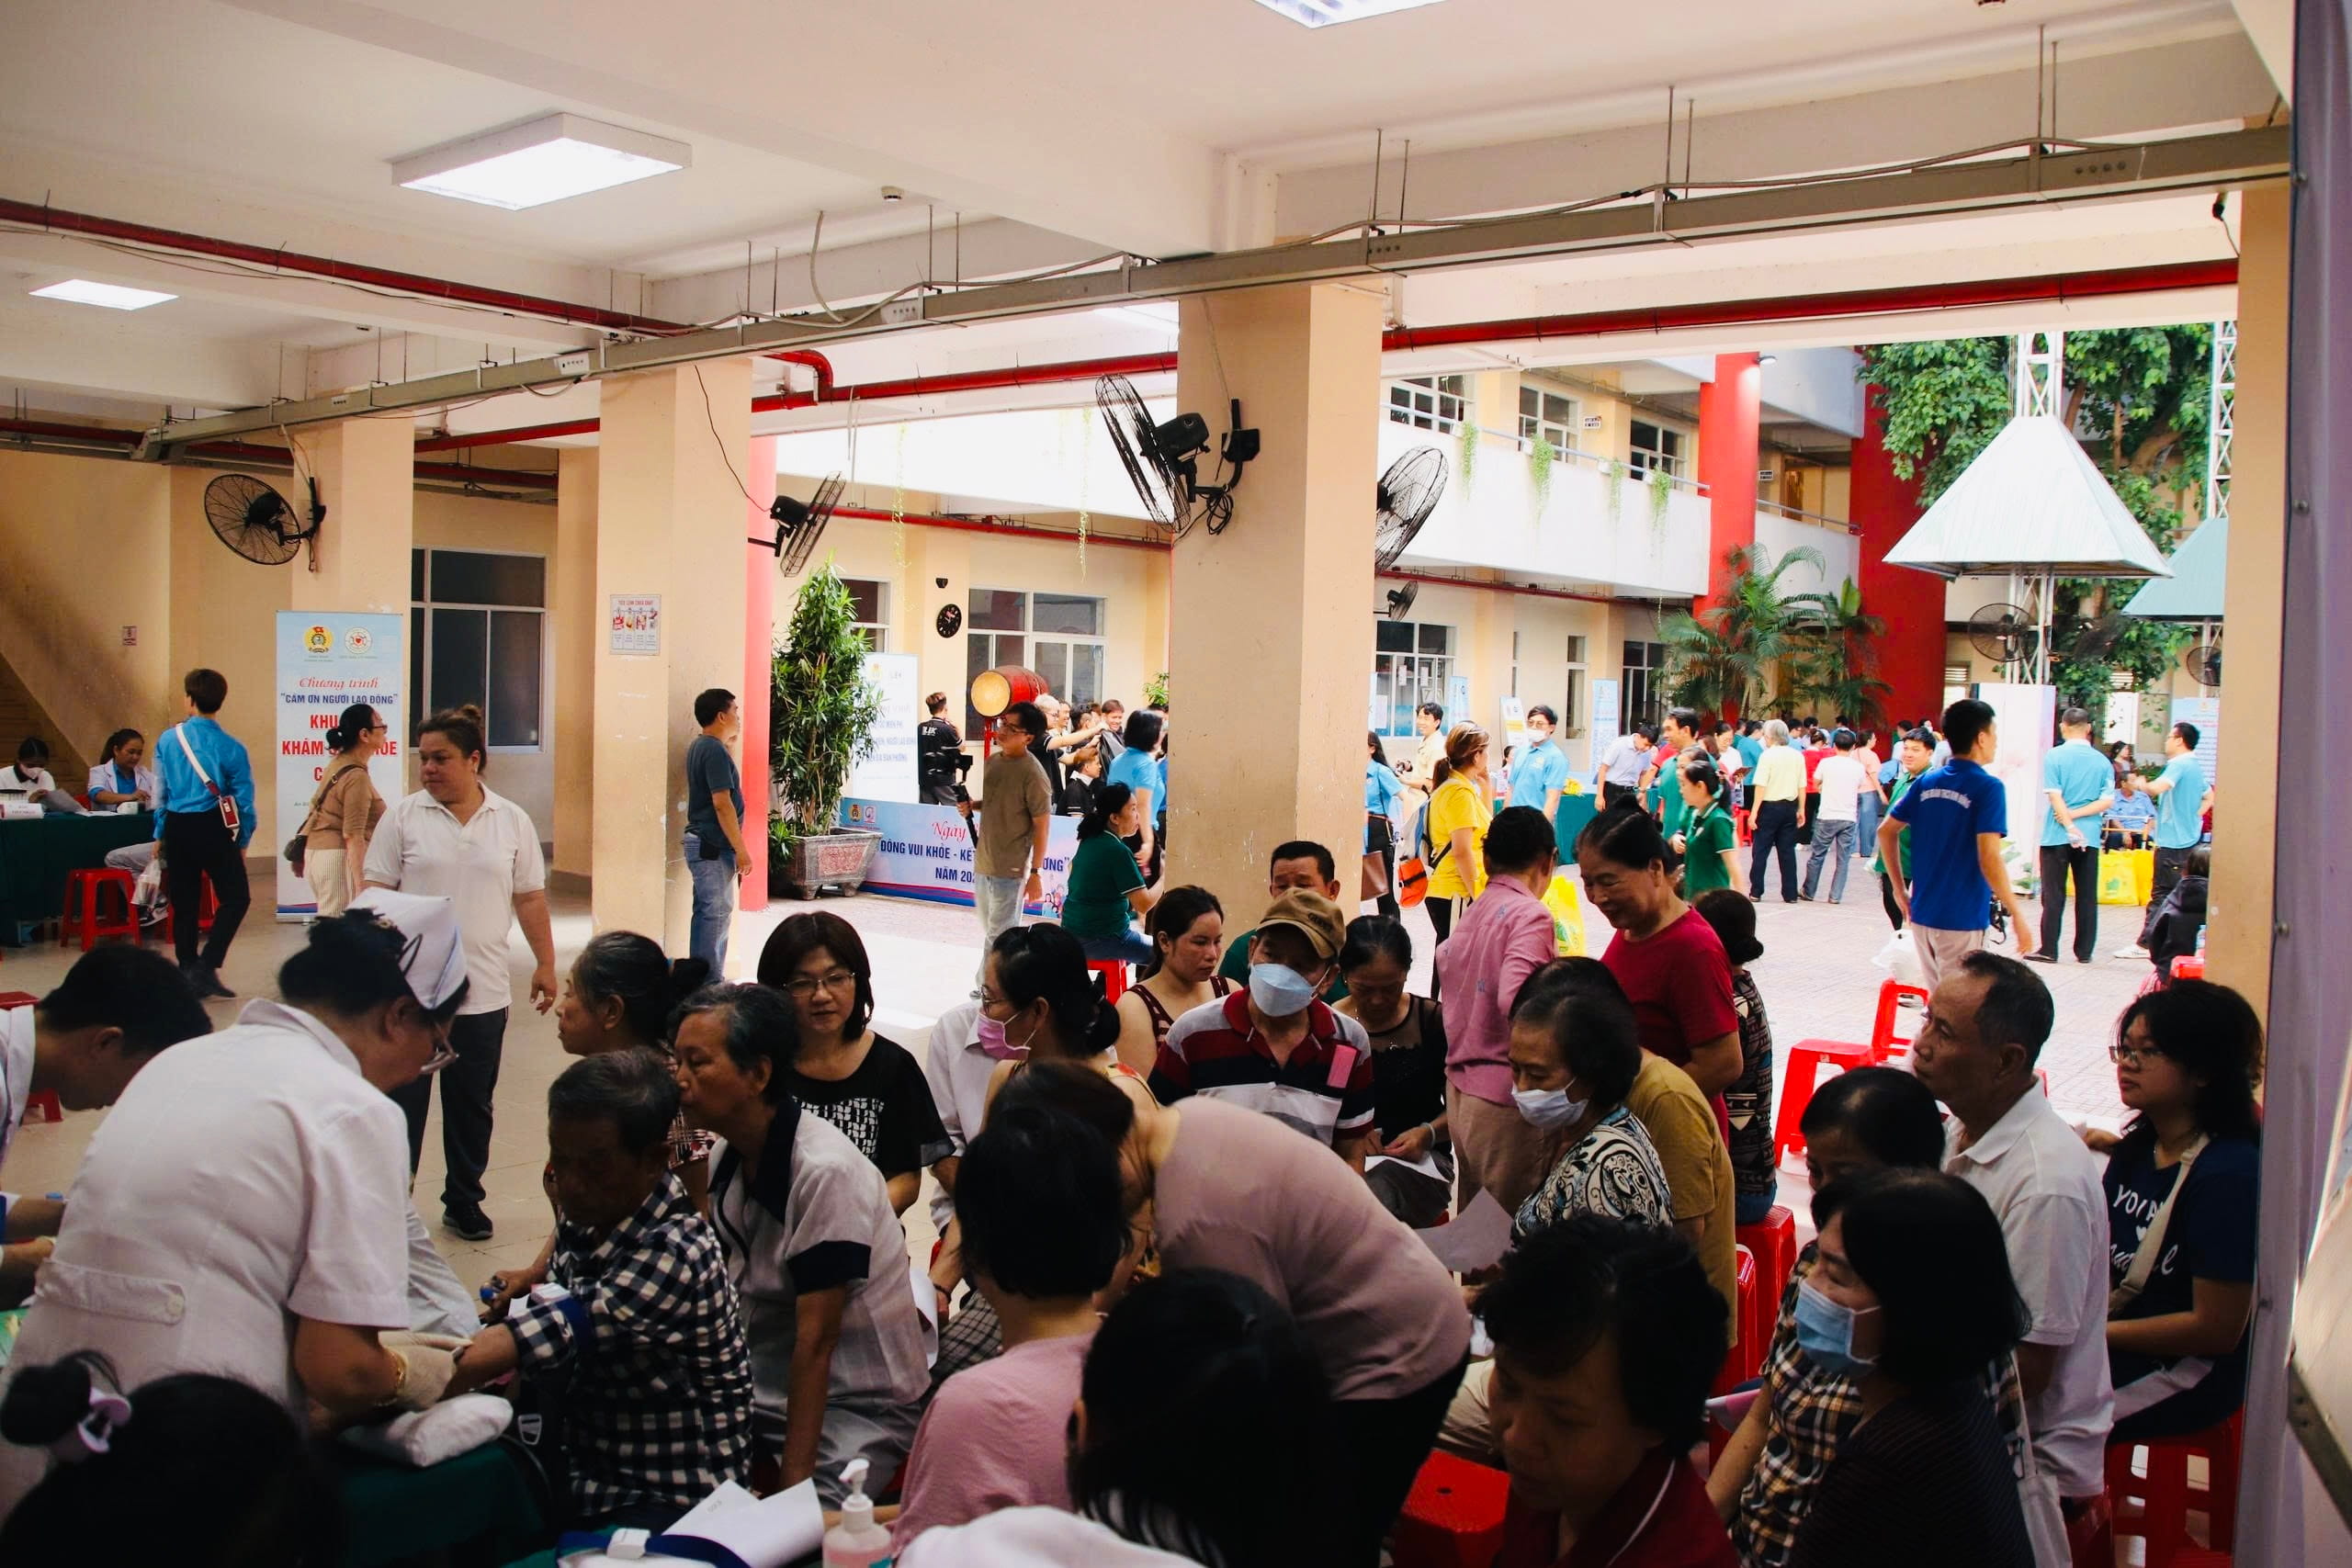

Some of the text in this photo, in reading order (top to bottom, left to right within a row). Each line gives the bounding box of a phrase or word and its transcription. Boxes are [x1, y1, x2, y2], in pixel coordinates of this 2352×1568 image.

[282, 738, 323, 755] KHÁM
[932, 821, 967, 842] Ngày
[908, 843, 923, 856] VUI
[926, 842, 950, 859] KHỎE
[935, 866, 976, 883] NĂM 20
